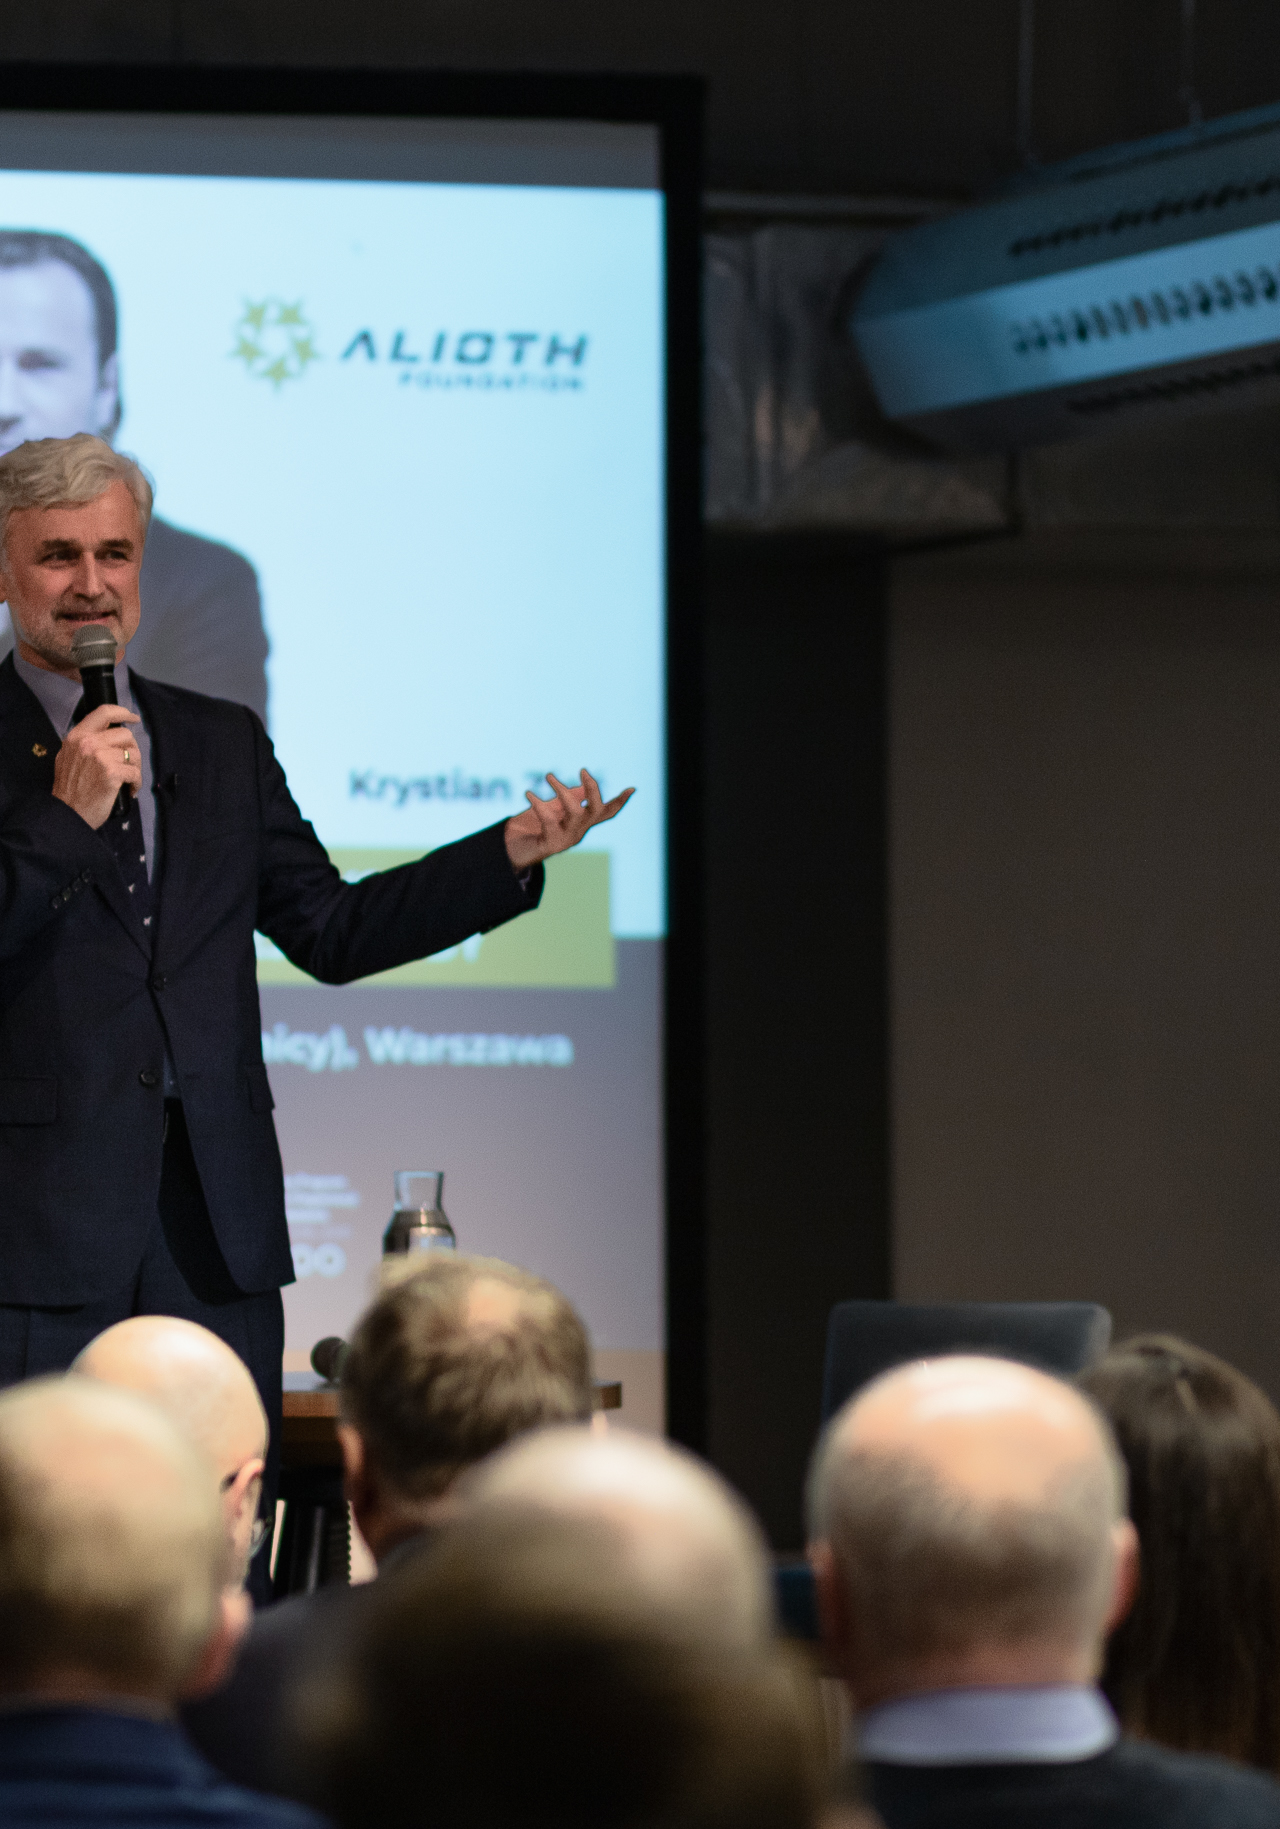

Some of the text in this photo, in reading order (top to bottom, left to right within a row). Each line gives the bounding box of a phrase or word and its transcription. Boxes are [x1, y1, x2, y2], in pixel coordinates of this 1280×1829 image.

[339, 328, 590, 369] ALIOTH
[348, 770, 513, 807] Krystian
[363, 1025, 575, 1068] Warszawa
